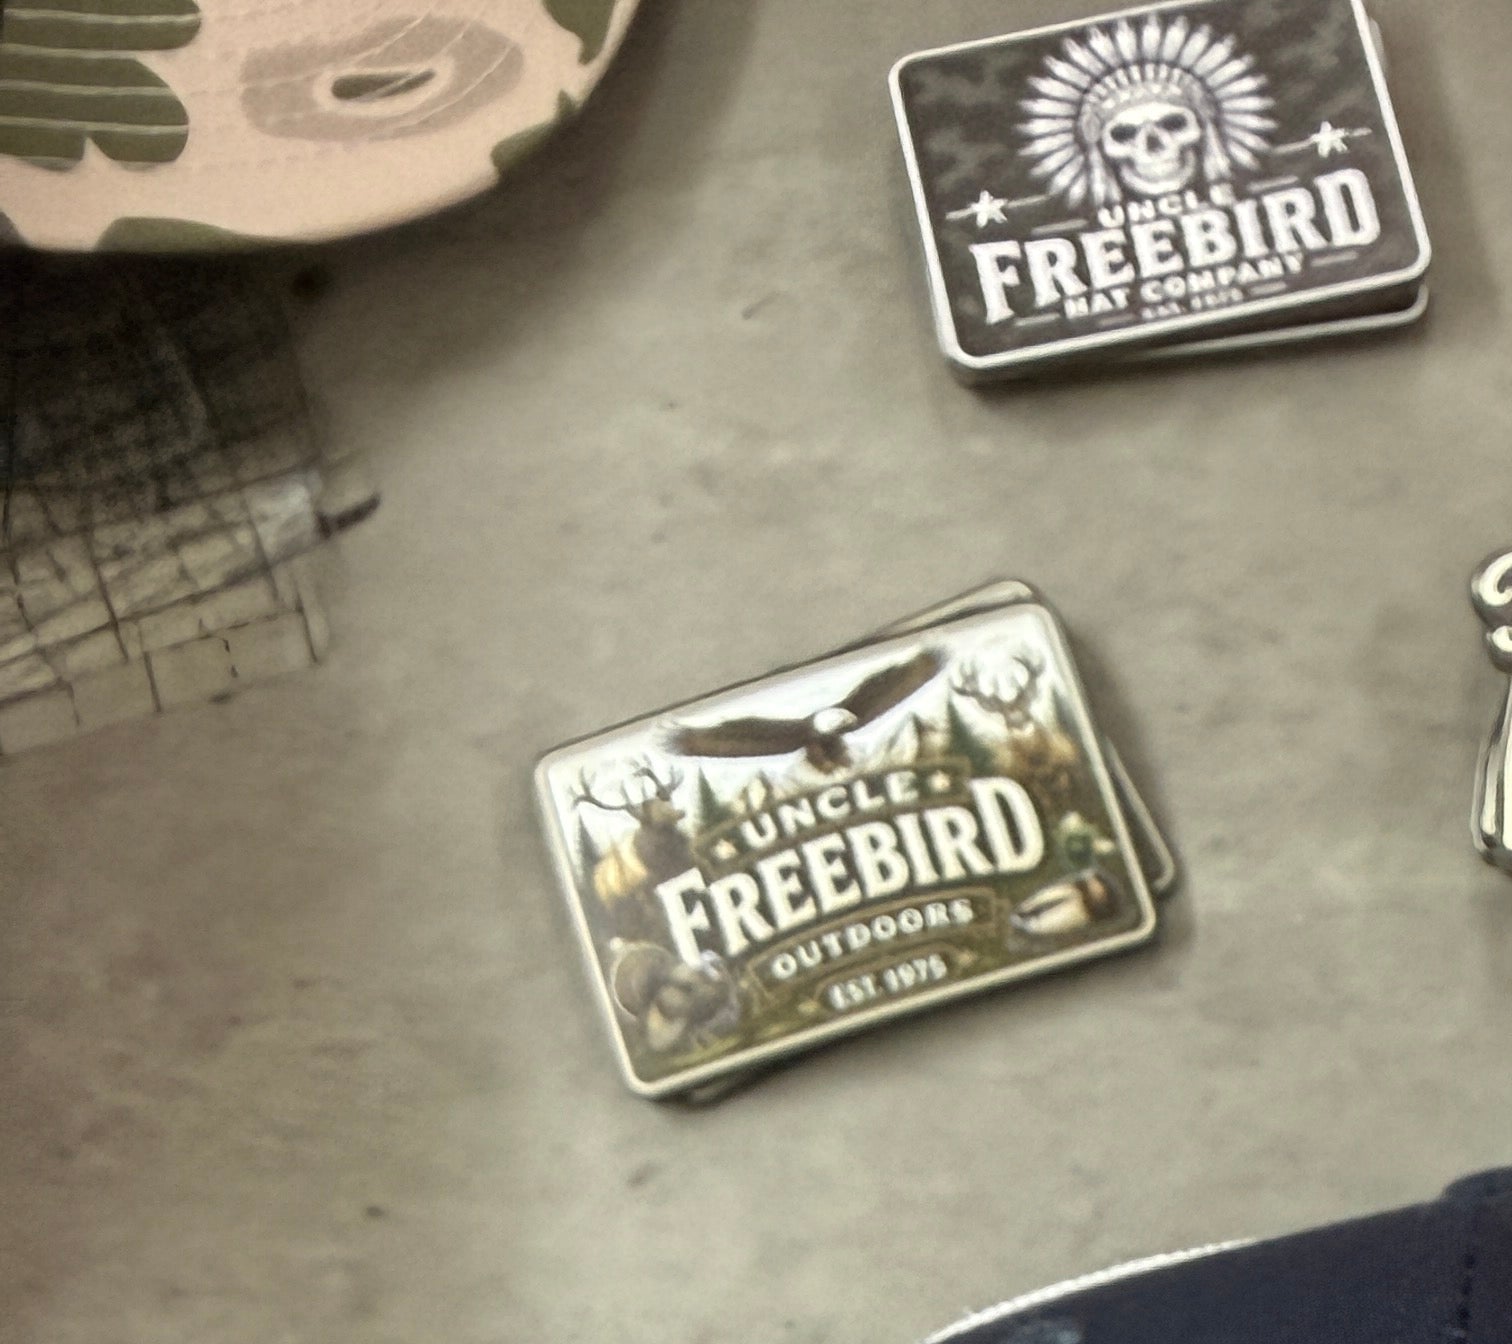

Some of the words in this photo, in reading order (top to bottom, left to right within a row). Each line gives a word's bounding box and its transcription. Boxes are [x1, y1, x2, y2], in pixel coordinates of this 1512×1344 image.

[969, 168, 1381, 325] FREEBIRD
[1140, 252, 1304, 304] COMPANY
[740, 771, 919, 848] UNCLE
[655, 776, 1045, 968] FREEBIRD
[771, 899, 974, 981] OUTDOORS
